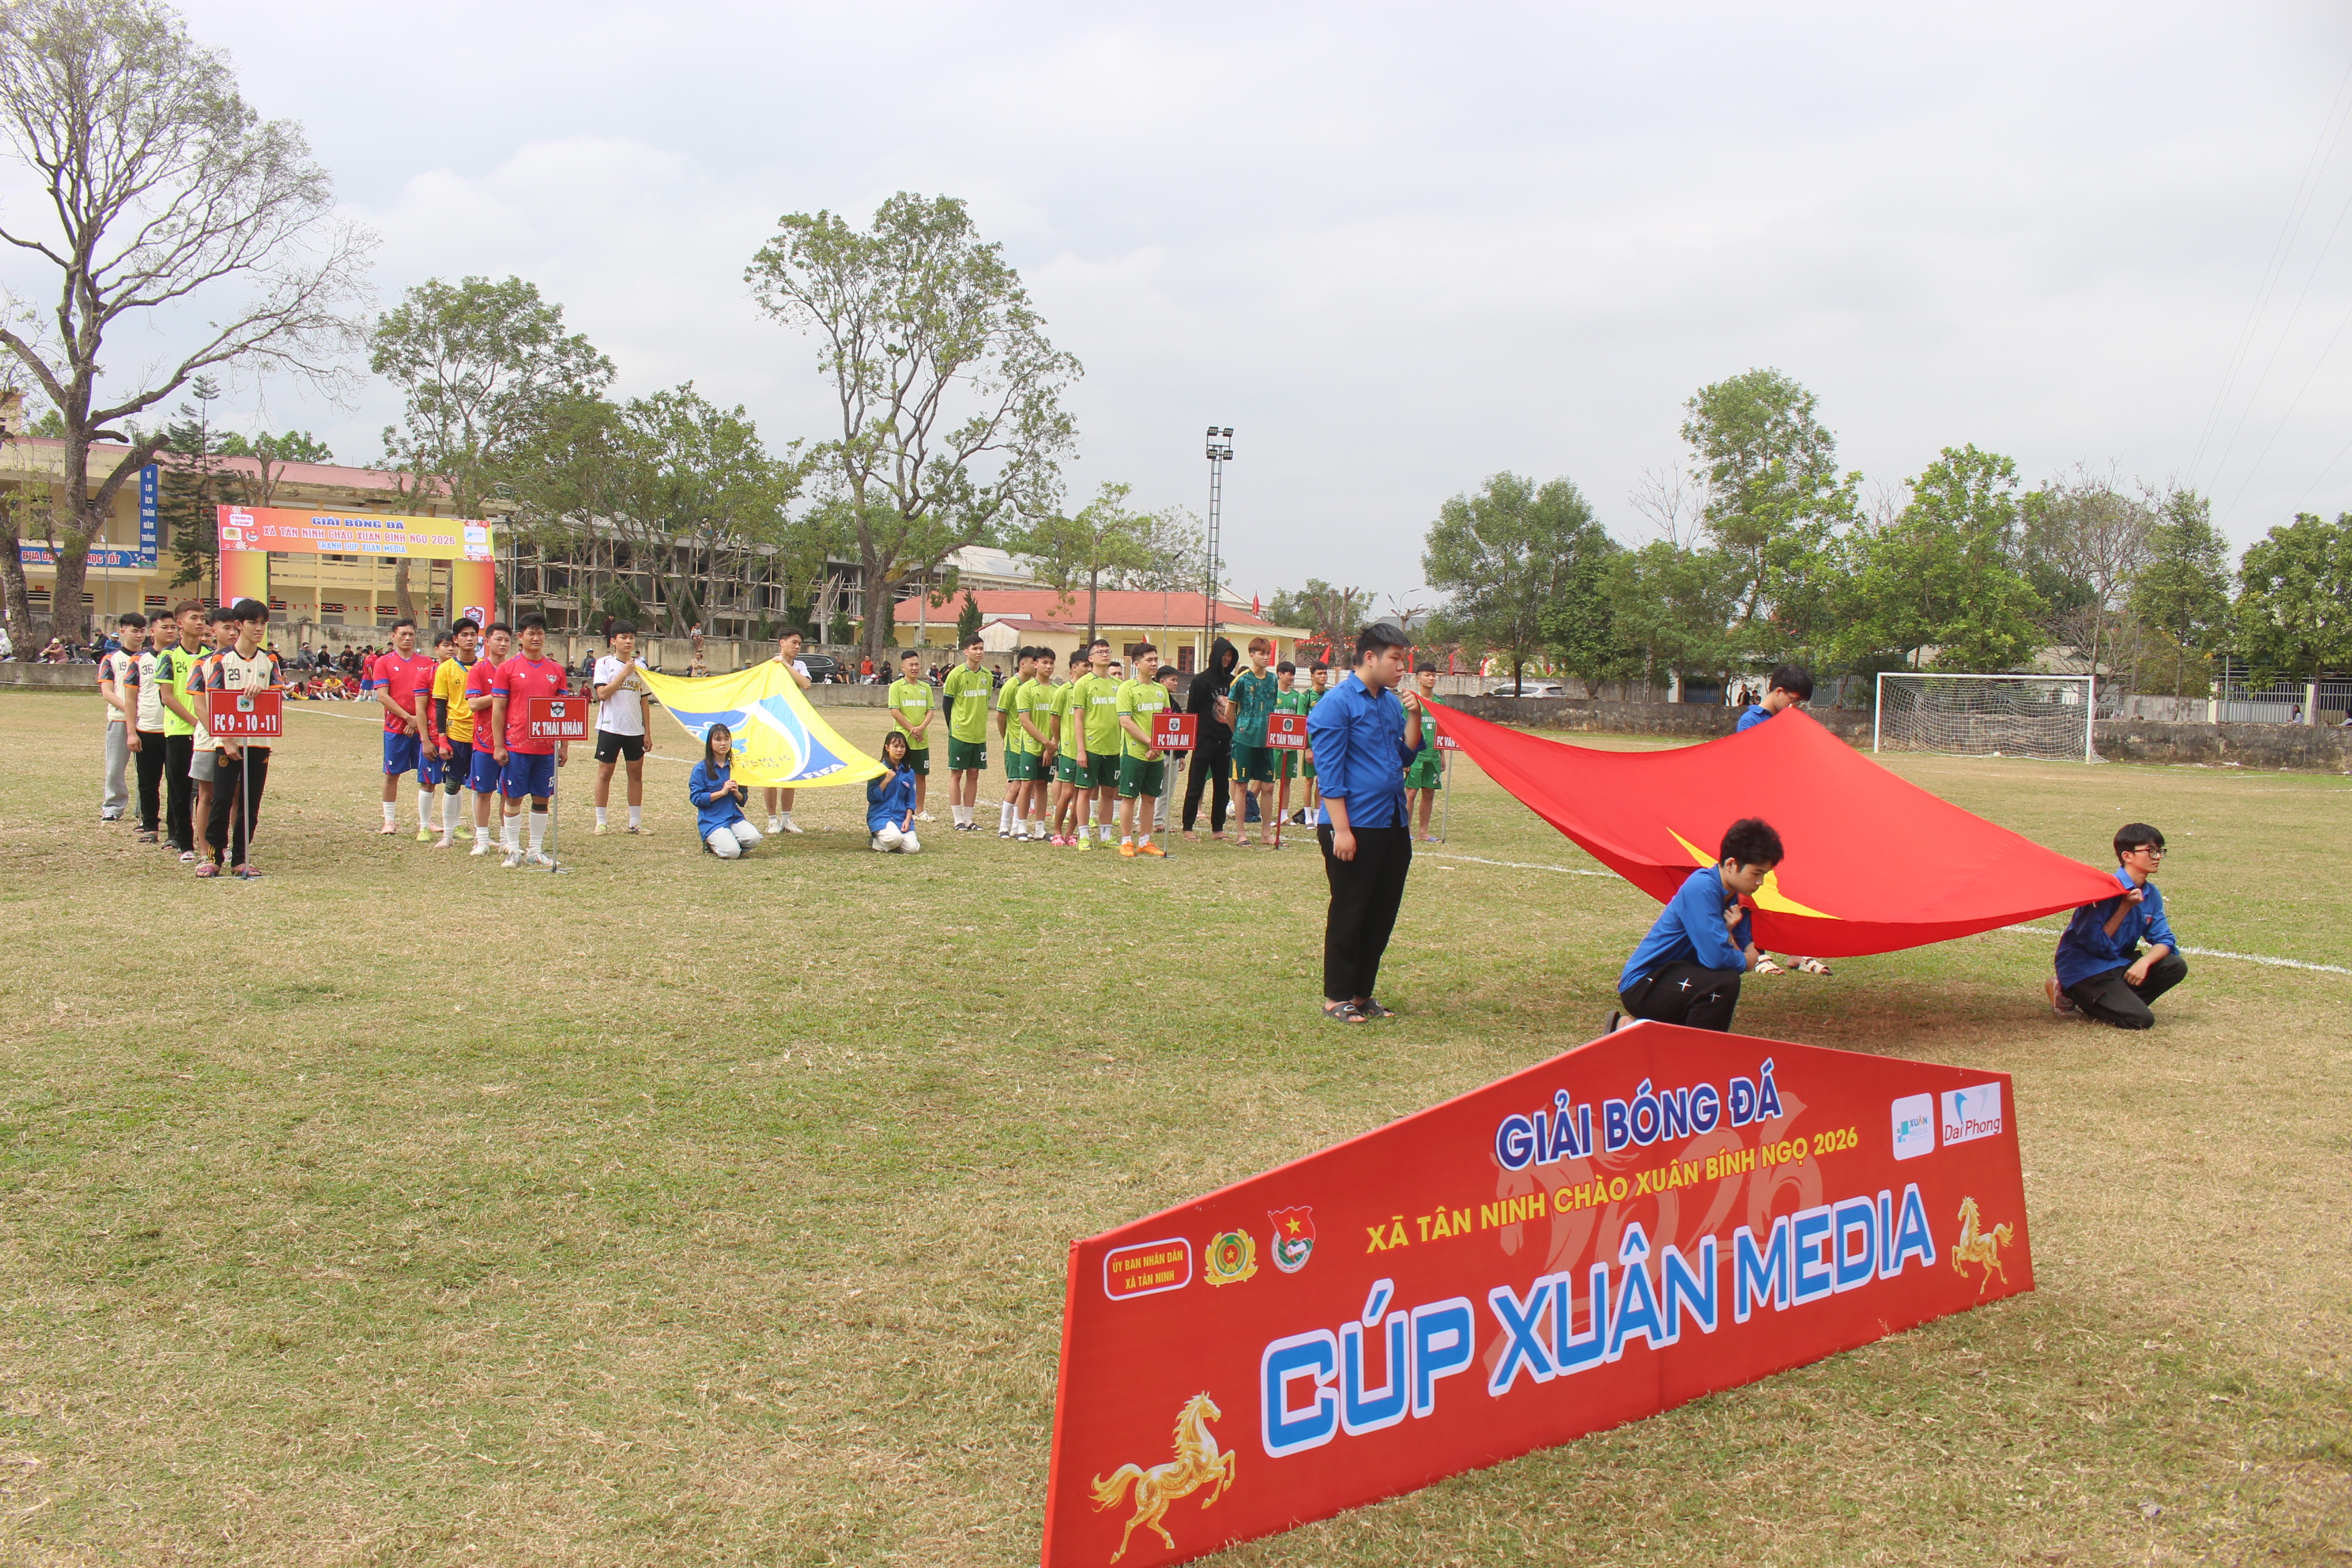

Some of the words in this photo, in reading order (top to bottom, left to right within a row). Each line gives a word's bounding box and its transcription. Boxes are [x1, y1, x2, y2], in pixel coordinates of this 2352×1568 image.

[145, 484, 153, 493] LỢI
[145, 495, 153, 504] ÍCH
[142, 508, 154, 517] TRĂM
[144, 519, 154, 529] NĂM
[312, 517, 341, 526] GIẢI
[344, 518, 382, 529] BÓNG
[386, 520, 405, 529] ĐÁ
[279, 526, 299, 538] TÂN
[301, 528, 325, 539] NINH
[328, 528, 353, 540] CHÀO
[356, 531, 380, 541] XUÂN
[409, 534, 428, 544] NGỌ
[431, 535, 455, 545] 2026
[317, 541, 342, 551] TRANH
[361, 542, 381, 552] XUÂN
[384, 544, 407, 553] MEDIA
[22, 551, 41, 561] ĐUA
[105, 552, 120, 565] TỐT
[119, 662, 127, 670] 19
[142, 664, 153, 674] 36
[176, 662, 188, 673] 24
[228, 668, 240, 681] 29
[902, 698, 916, 706] LÀNG
[1092, 696, 1107, 704] LÀNG
[1138, 702, 1153, 711] LÀNG
[214, 714, 226, 731] FC
[228, 715, 235, 731] 9
[246, 715, 258, 731] 10
[532, 722, 541, 735] FC
[543, 719, 559, 735] THÁI
[561, 719, 583, 735] NHÂN
[1158, 734, 1165, 746] FC
[1166, 732, 1179, 746] TÂN
[1179, 734, 1189, 746] AN
[1269, 733, 1276, 745] FC
[1276, 732, 1286, 745] TÂN
[1287, 734, 1304, 746] THANH
[1437, 736, 1443, 747] FC
[802, 764, 845, 779] FIFA
[1494, 1088, 1592, 1171] GIẢI
[1602, 1077, 1720, 1153] BÓNG
[1728, 1057, 1784, 1128] ĐÁ
[1909, 1115, 1928, 1128] XUÂN
[1944, 1121, 1963, 1141] Dai
[1965, 1118, 2001, 1136] Phong
[1366, 1214, 1410, 1254] XÃ
[1416, 1204, 1471, 1244] TÂN
[1480, 1192, 1546, 1231] NINH
[1553, 1173, 1629, 1213] CHÀO
[1635, 1159, 1699, 1196] XUÂN
[1705, 1147, 1756, 1181] BÍNH
[1762, 1137, 1808, 1166] NGỌ
[1814, 1126, 1859, 1156] 2026
[1112, 1258, 1123, 1273] ỦY
[1124, 1256, 1142, 1271] BAN
[1143, 1251, 1166, 1268] NHÂN
[1167, 1249, 1184, 1264] DÂN
[1125, 1275, 1137, 1290] XÃ
[1138, 1272, 1154, 1287] TÂN
[1155, 1270, 1175, 1285] NINH
[1261, 1278, 1474, 1458] CÚP
[1488, 1222, 1718, 1397] XUÂN
[1734, 1182, 1936, 1324] MEDIA
